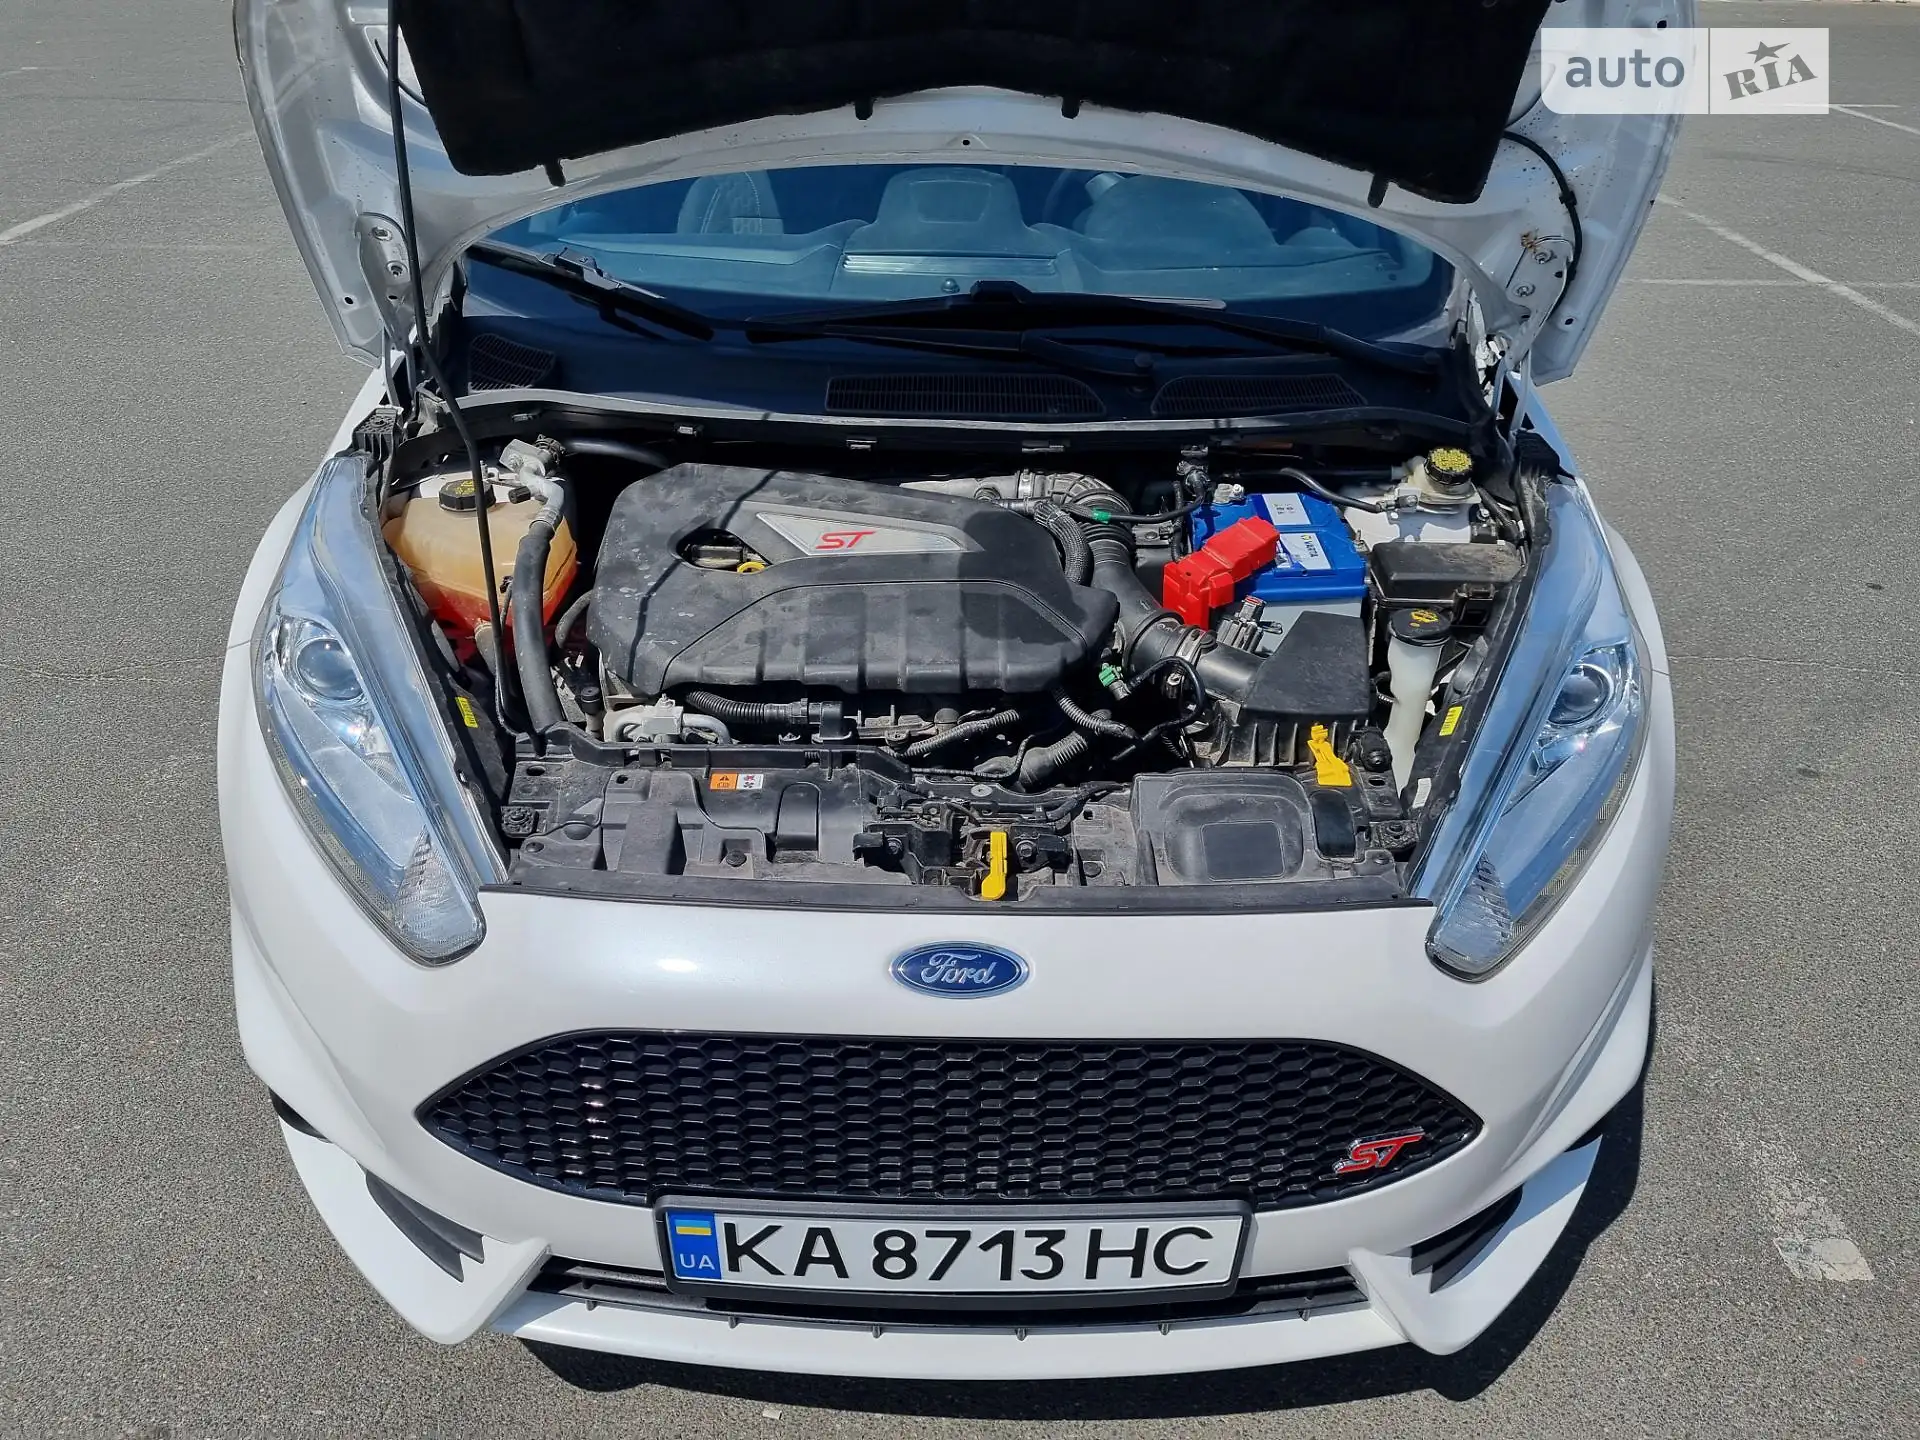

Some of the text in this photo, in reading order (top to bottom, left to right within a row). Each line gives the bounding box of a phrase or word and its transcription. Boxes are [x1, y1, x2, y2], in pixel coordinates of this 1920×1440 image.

[815, 531, 876, 549] ST
[921, 952, 997, 984] Ford
[1334, 1130, 1425, 1173] ST
[679, 1253, 715, 1270] UA
[723, 1222, 1214, 1281] KA 8713 HC
